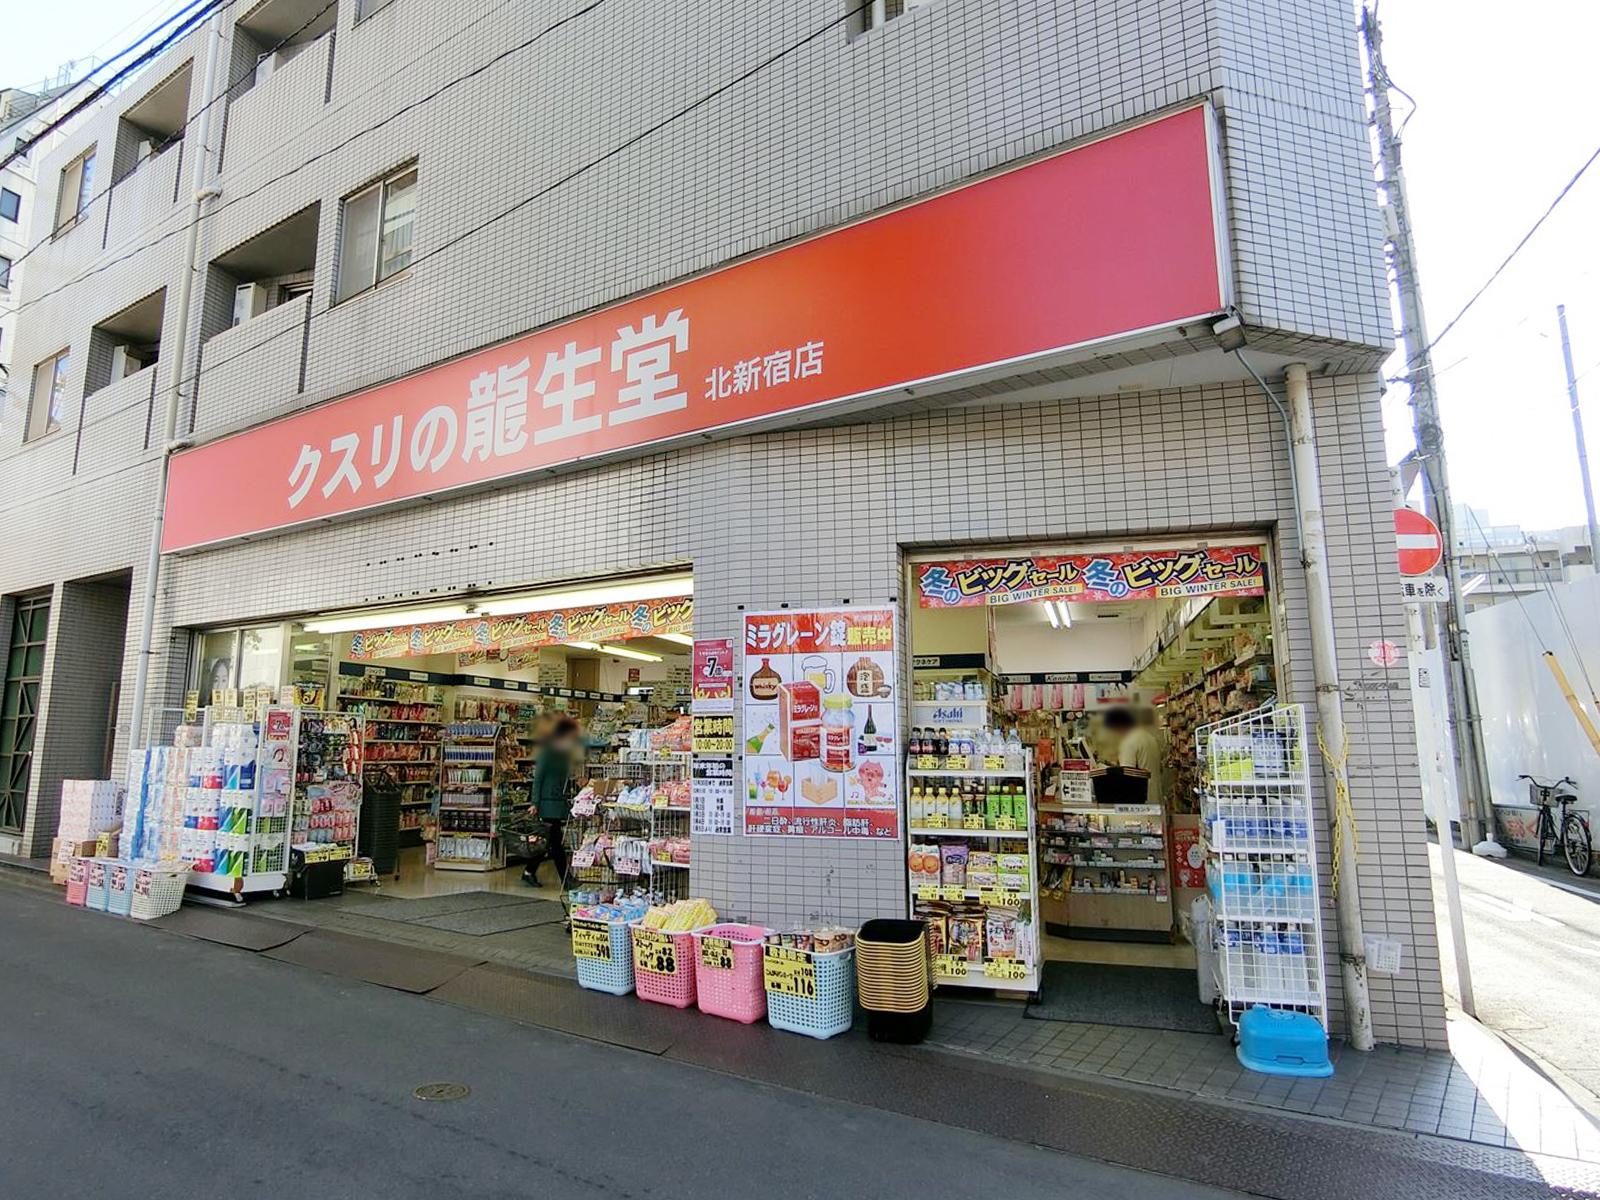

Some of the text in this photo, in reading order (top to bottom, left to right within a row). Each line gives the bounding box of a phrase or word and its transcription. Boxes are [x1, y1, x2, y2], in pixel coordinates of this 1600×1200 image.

[287, 308, 824, 509] クスリの龍生堂 北新宿店
[921, 559, 1081, 604] 冬のビッグセール
[1083, 551, 1260, 597] 冬のビッグセール
[989, 585, 1077, 604] BIG WINTER SALE!
[1161, 578, 1257, 596] BIG WINTER SALE!
[913, 658, 938, 666] クネケア
[933, 707, 963, 719] Asahi
[694, 718, 733, 735] 営業時間
[1002, 898, 1020, 907] 100
[656, 956, 675, 973] 88
[720, 956, 732, 969] 88
[950, 968, 967, 976] 100
[1008, 971, 1026, 979] 100
[794, 977, 814, 996] 116
